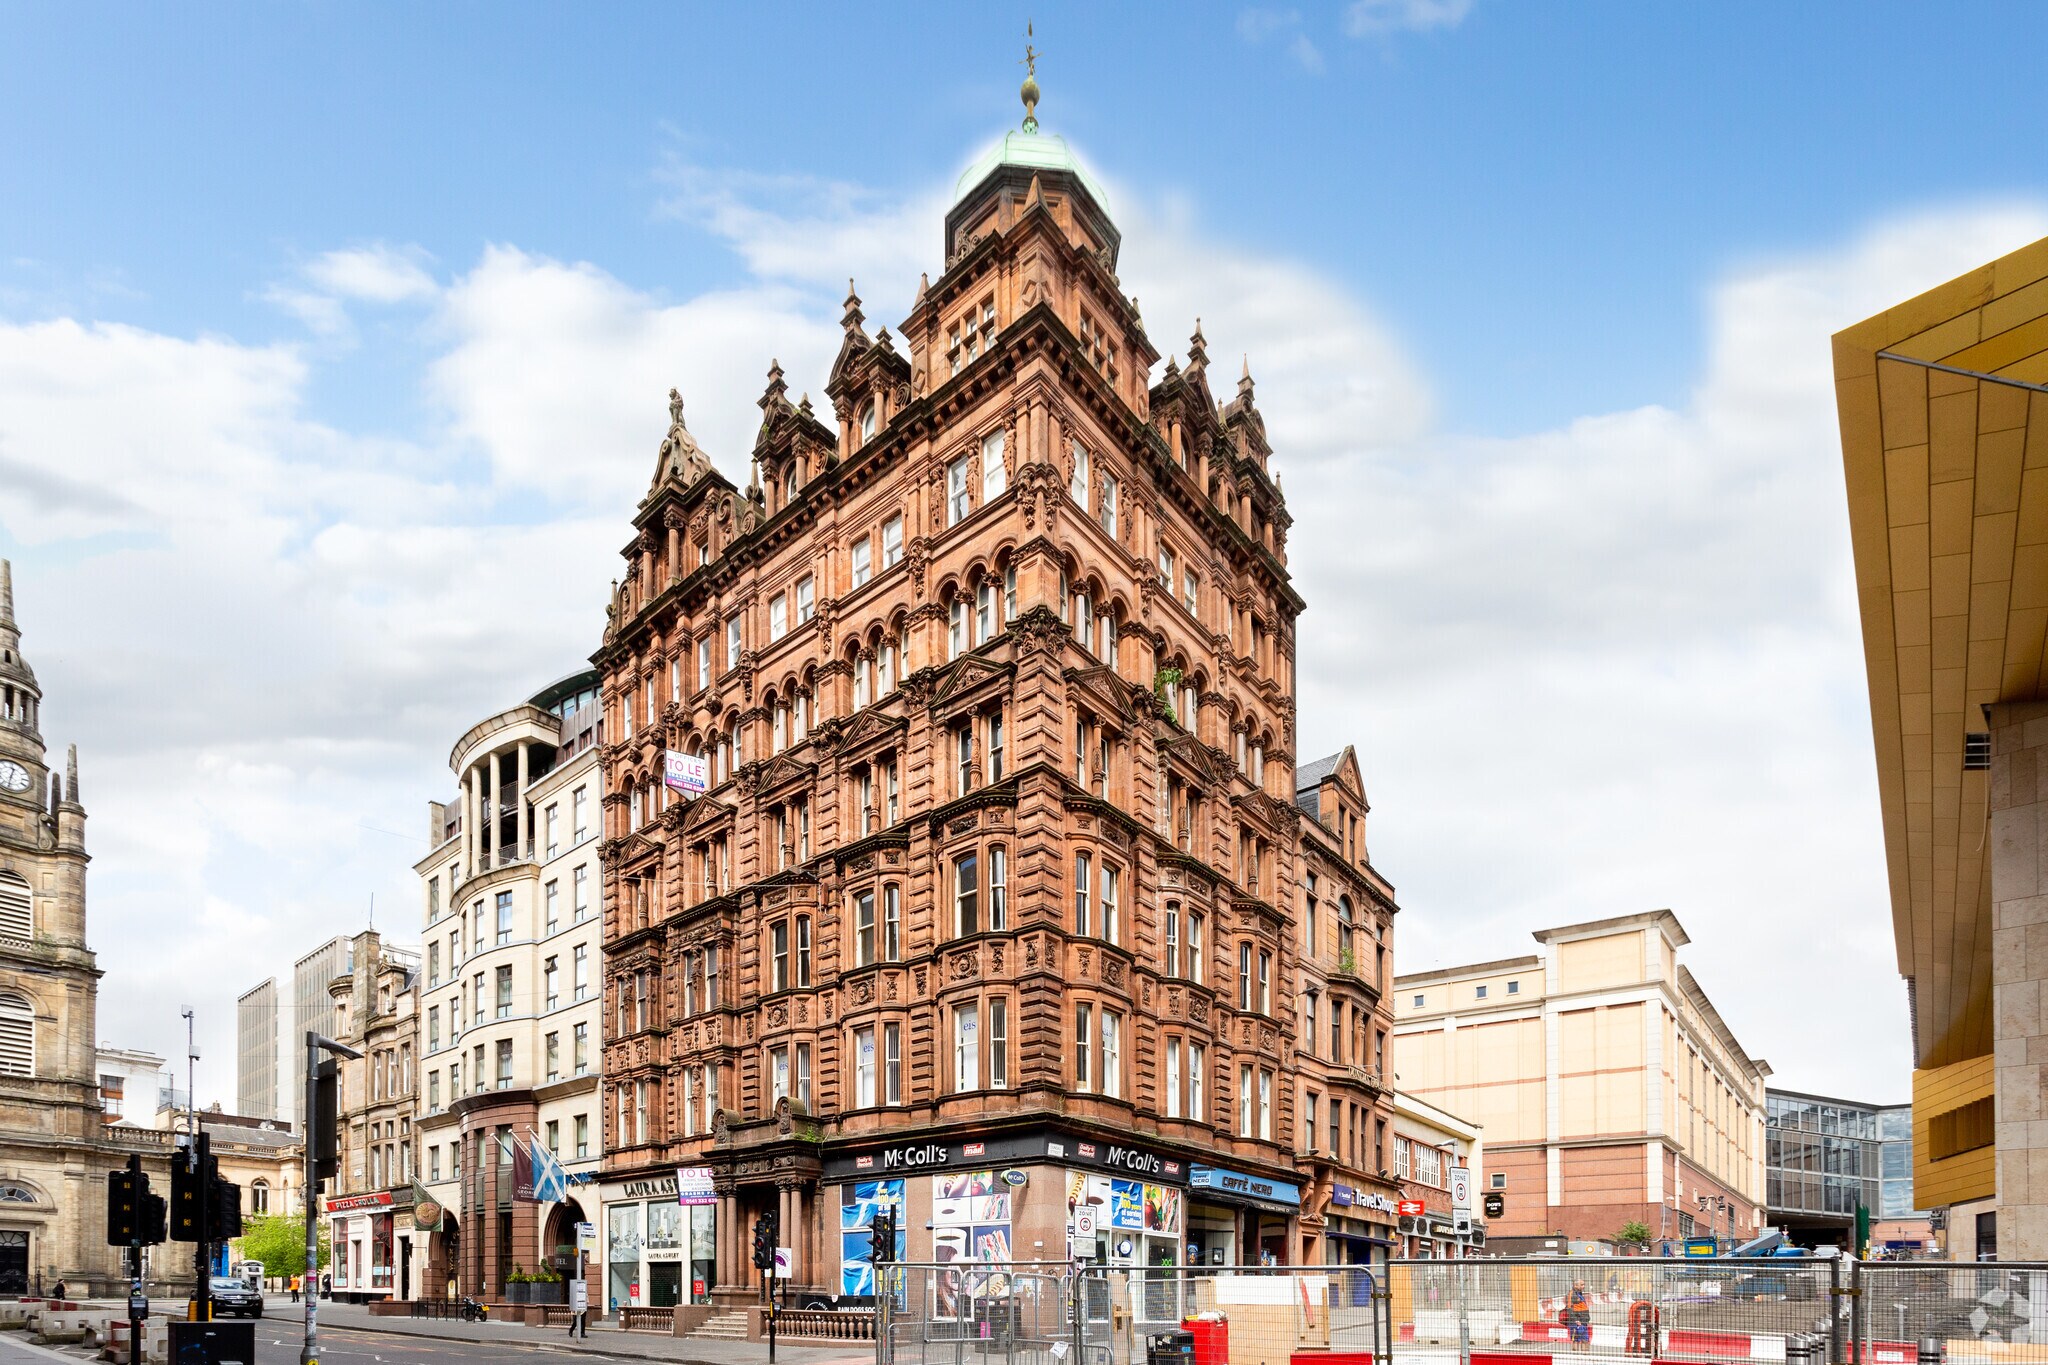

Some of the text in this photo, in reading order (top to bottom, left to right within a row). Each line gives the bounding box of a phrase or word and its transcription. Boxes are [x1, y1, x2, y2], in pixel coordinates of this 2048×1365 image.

[668, 758, 705, 777] TO LE
[863, 1043, 874, 1052] eis
[884, 1145, 947, 1168] McColl's
[1107, 1146, 1160, 1173] McColl's
[679, 1168, 714, 1178] TO LE
[1454, 1174, 1466, 1182] ZONE
[623, 1181, 659, 1197] LAURA
[1250, 1182, 1273, 1196] NERO
[336, 1200, 355, 1209] PIZZA
[878, 1195, 888, 1204] 100
[1122, 1199, 1131, 1209] 100
[1355, 1188, 1395, 1216] Travel Shop
[1122, 1216, 1142, 1226] Scotland
